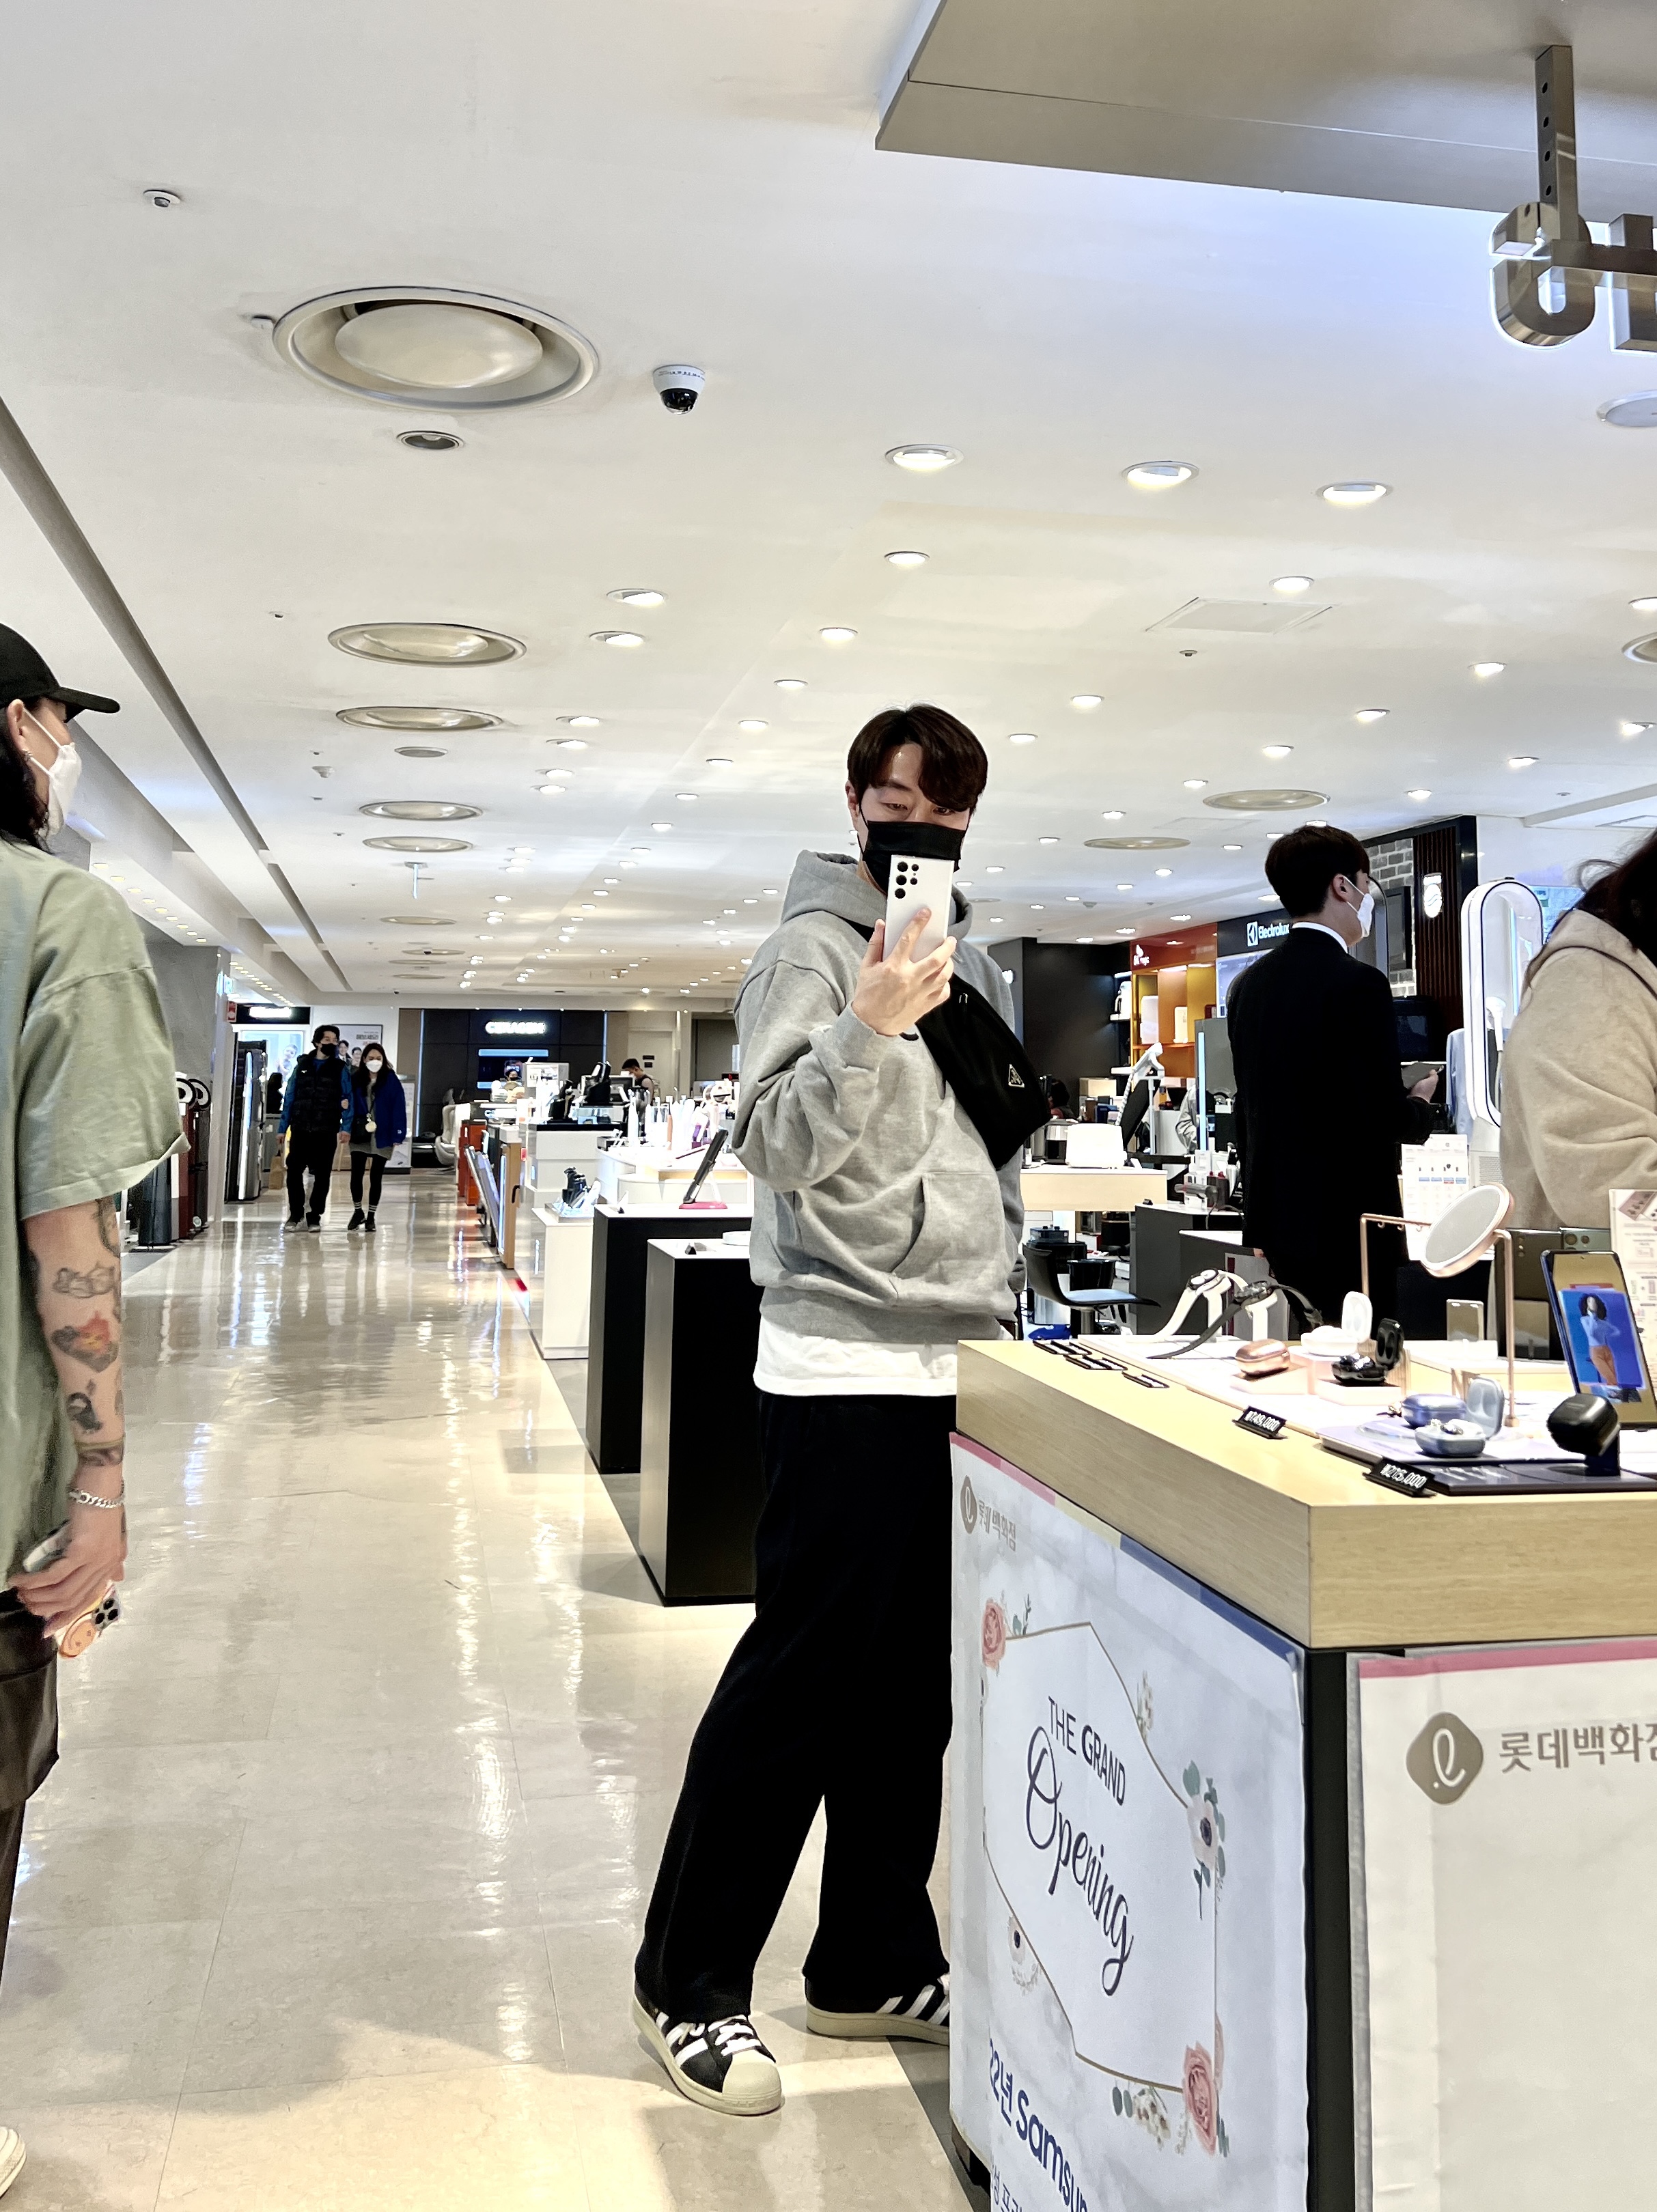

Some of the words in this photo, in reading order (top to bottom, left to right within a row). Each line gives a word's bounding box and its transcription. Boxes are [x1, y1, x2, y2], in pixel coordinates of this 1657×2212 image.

[1258, 923, 1290, 938] Electrolux
[979, 1500, 1016, 1552] 롯데백화점
[1048, 1696, 1076, 1755] THE
[1081, 1724, 1126, 1806] GRAND
[1026, 1726, 1134, 1996] Opening
